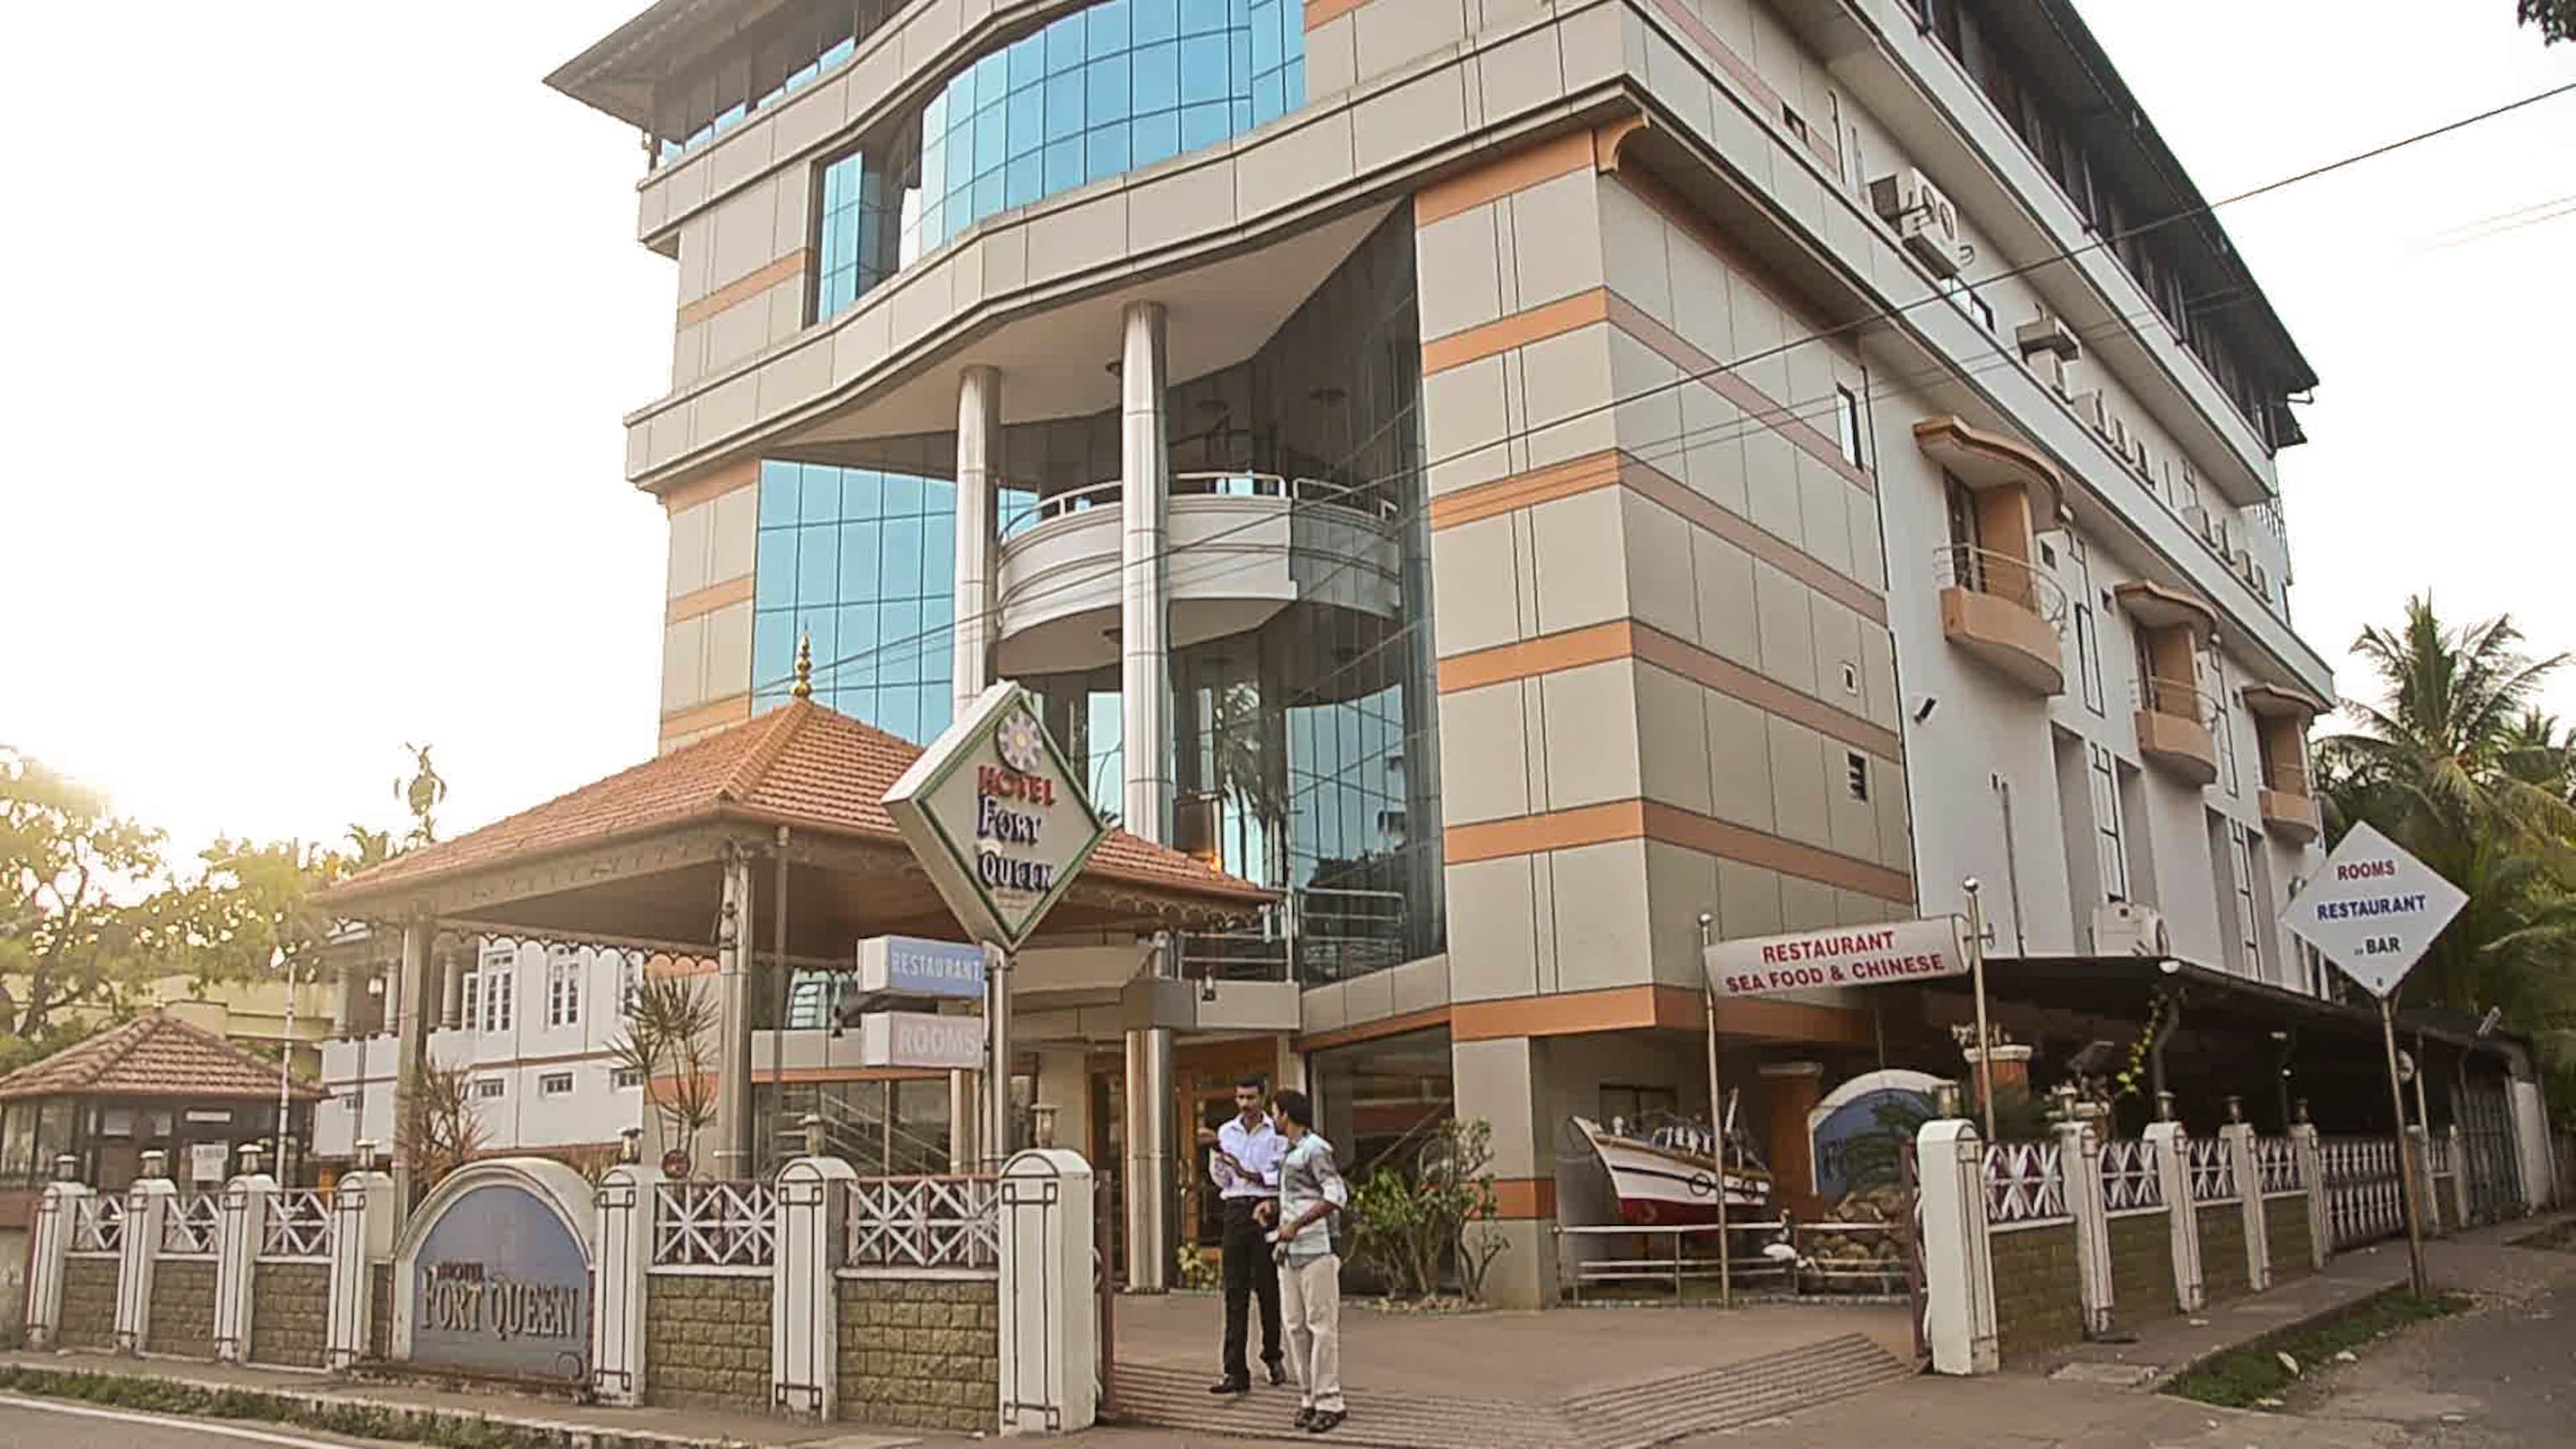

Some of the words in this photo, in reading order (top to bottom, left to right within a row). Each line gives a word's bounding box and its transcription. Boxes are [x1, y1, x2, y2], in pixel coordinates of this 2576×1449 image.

[978, 765, 1054, 805] HOTEL
[977, 850, 1053, 892] QUEEN
[2337, 860, 2396, 880] ROOMS
[2317, 895, 2426, 920] RESTAURANT
[1763, 931, 1894, 963] RESTAURANT
[2366, 937, 2401, 954] BAR
[891, 952, 984, 983] RESTAURANT
[1726, 976, 1764, 993] SEA
[1770, 968, 1823, 988] FOOD
[1831, 965, 1844, 981] &
[1852, 954, 1945, 979] CHINESE
[899, 1024, 978, 1058] ROOMS
[421, 1266, 486, 1332] FORT
[489, 1275, 579, 1340] QUEEN
